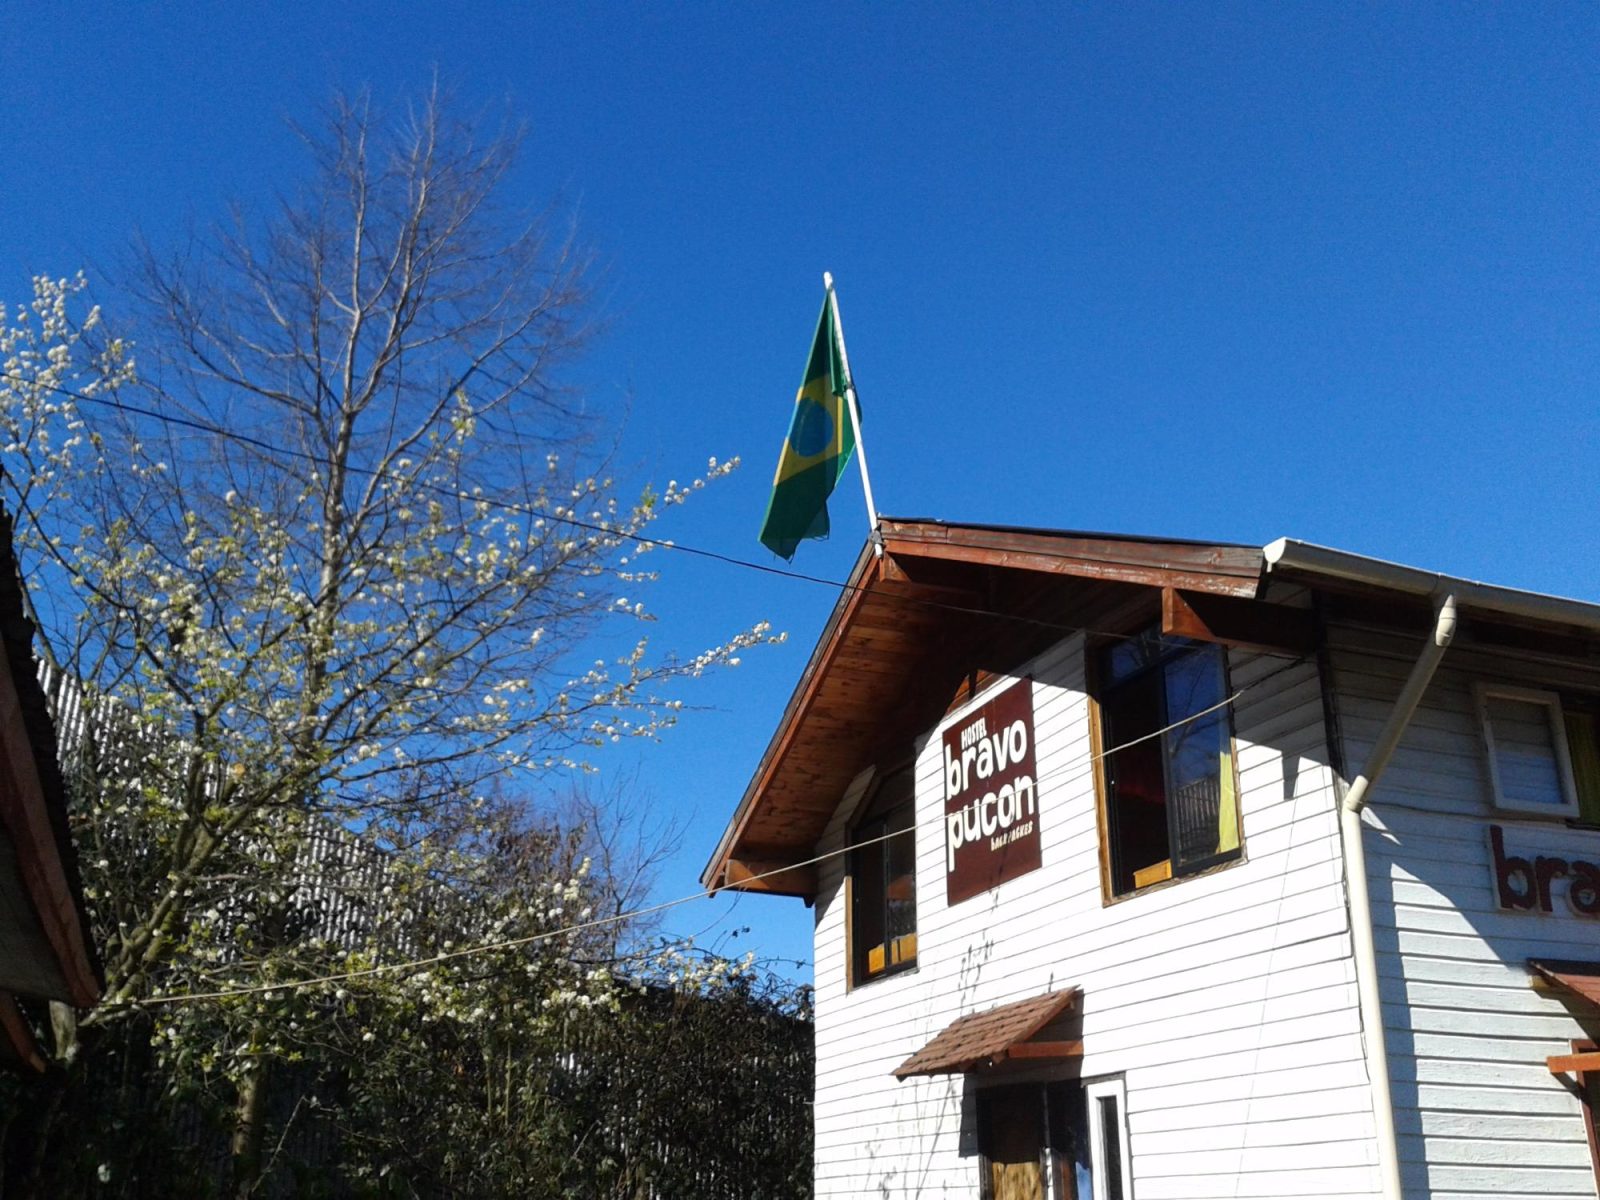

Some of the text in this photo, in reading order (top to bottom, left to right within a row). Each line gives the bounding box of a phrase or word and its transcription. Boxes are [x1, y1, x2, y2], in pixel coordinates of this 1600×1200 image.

[945, 719, 1028, 801] bravo
[961, 717, 987, 750] HOSTEL
[948, 775, 1035, 873] pucon
[1489, 825, 1600, 915] bra
